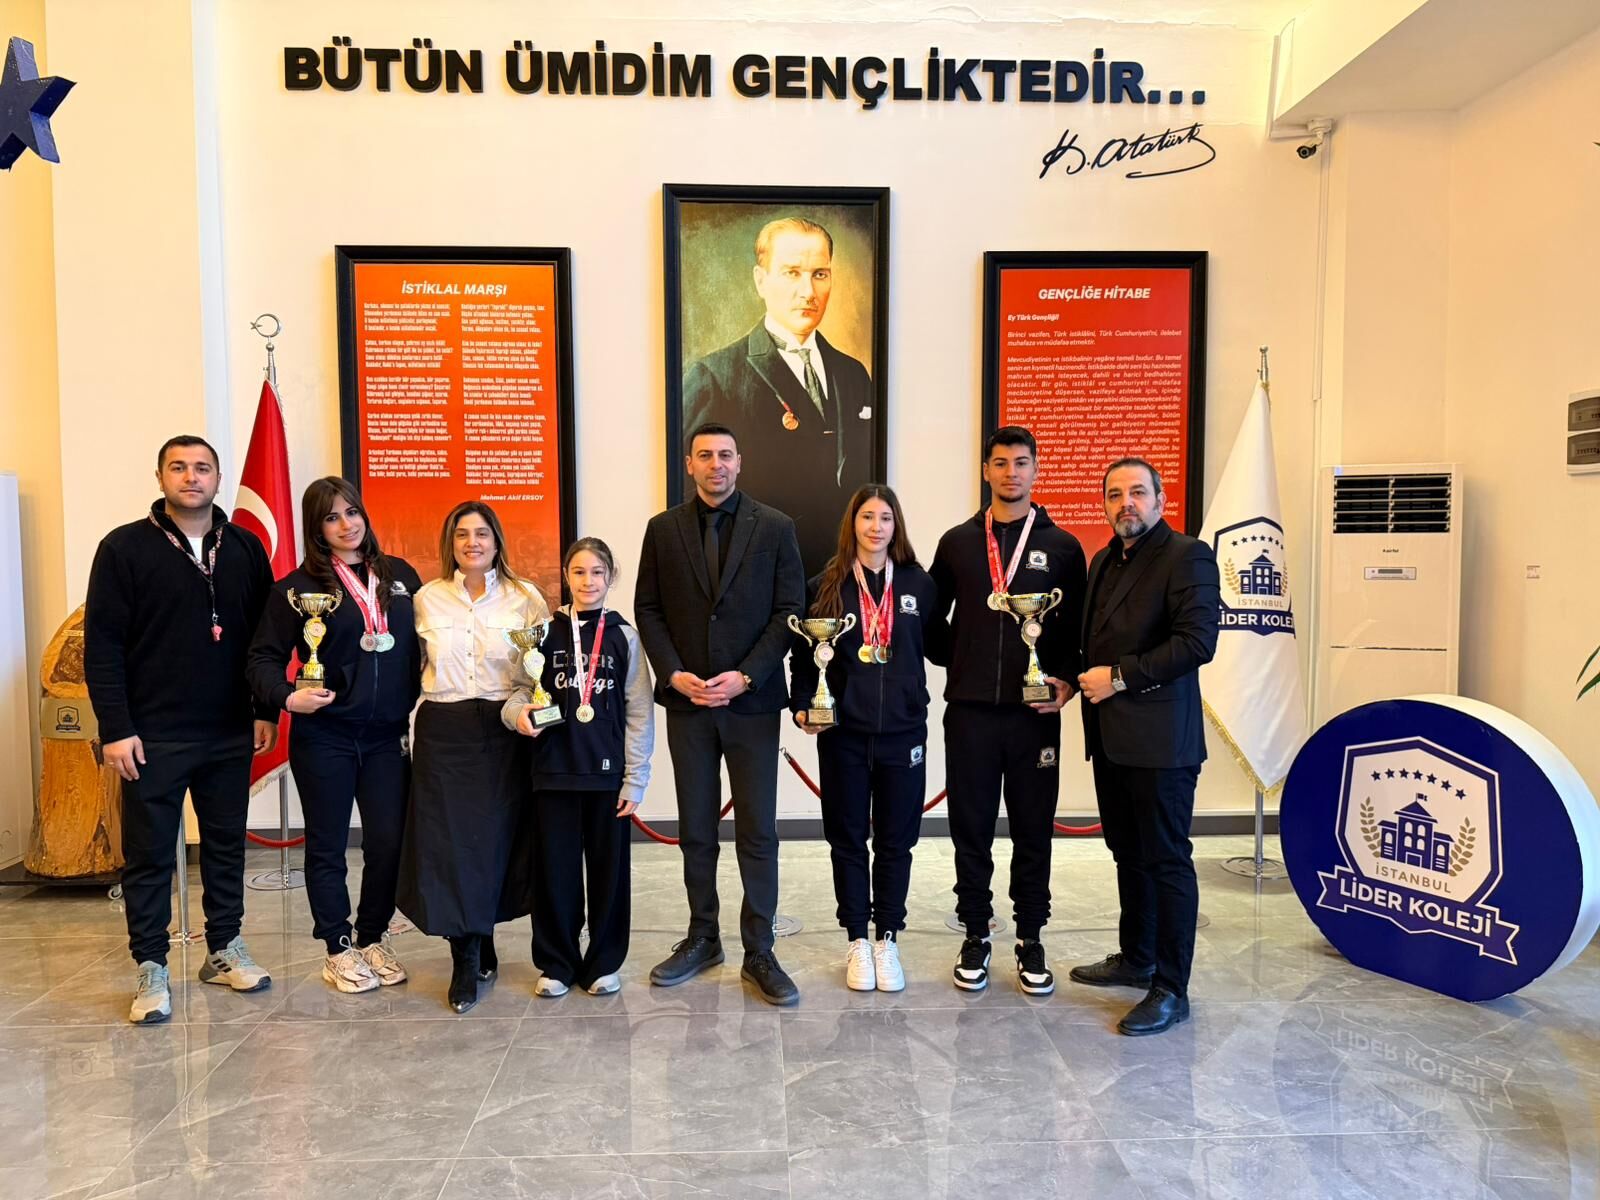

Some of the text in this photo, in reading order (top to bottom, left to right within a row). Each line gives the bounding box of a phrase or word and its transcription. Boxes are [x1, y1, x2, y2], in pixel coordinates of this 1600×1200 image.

[284, 36, 1205, 110] BÜTÜN ÜMİDİM GENÇLİKTEDİR...
[402, 280, 507, 298] İSTİKLAL MARŞI
[1038, 285, 1151, 302] GENÇLİĞE HİTABE
[1218, 610, 1258, 625] İDER
[1376, 863, 1451, 894] İSTANBUL
[1340, 877, 1492, 937] LİDER KOLEJİ
